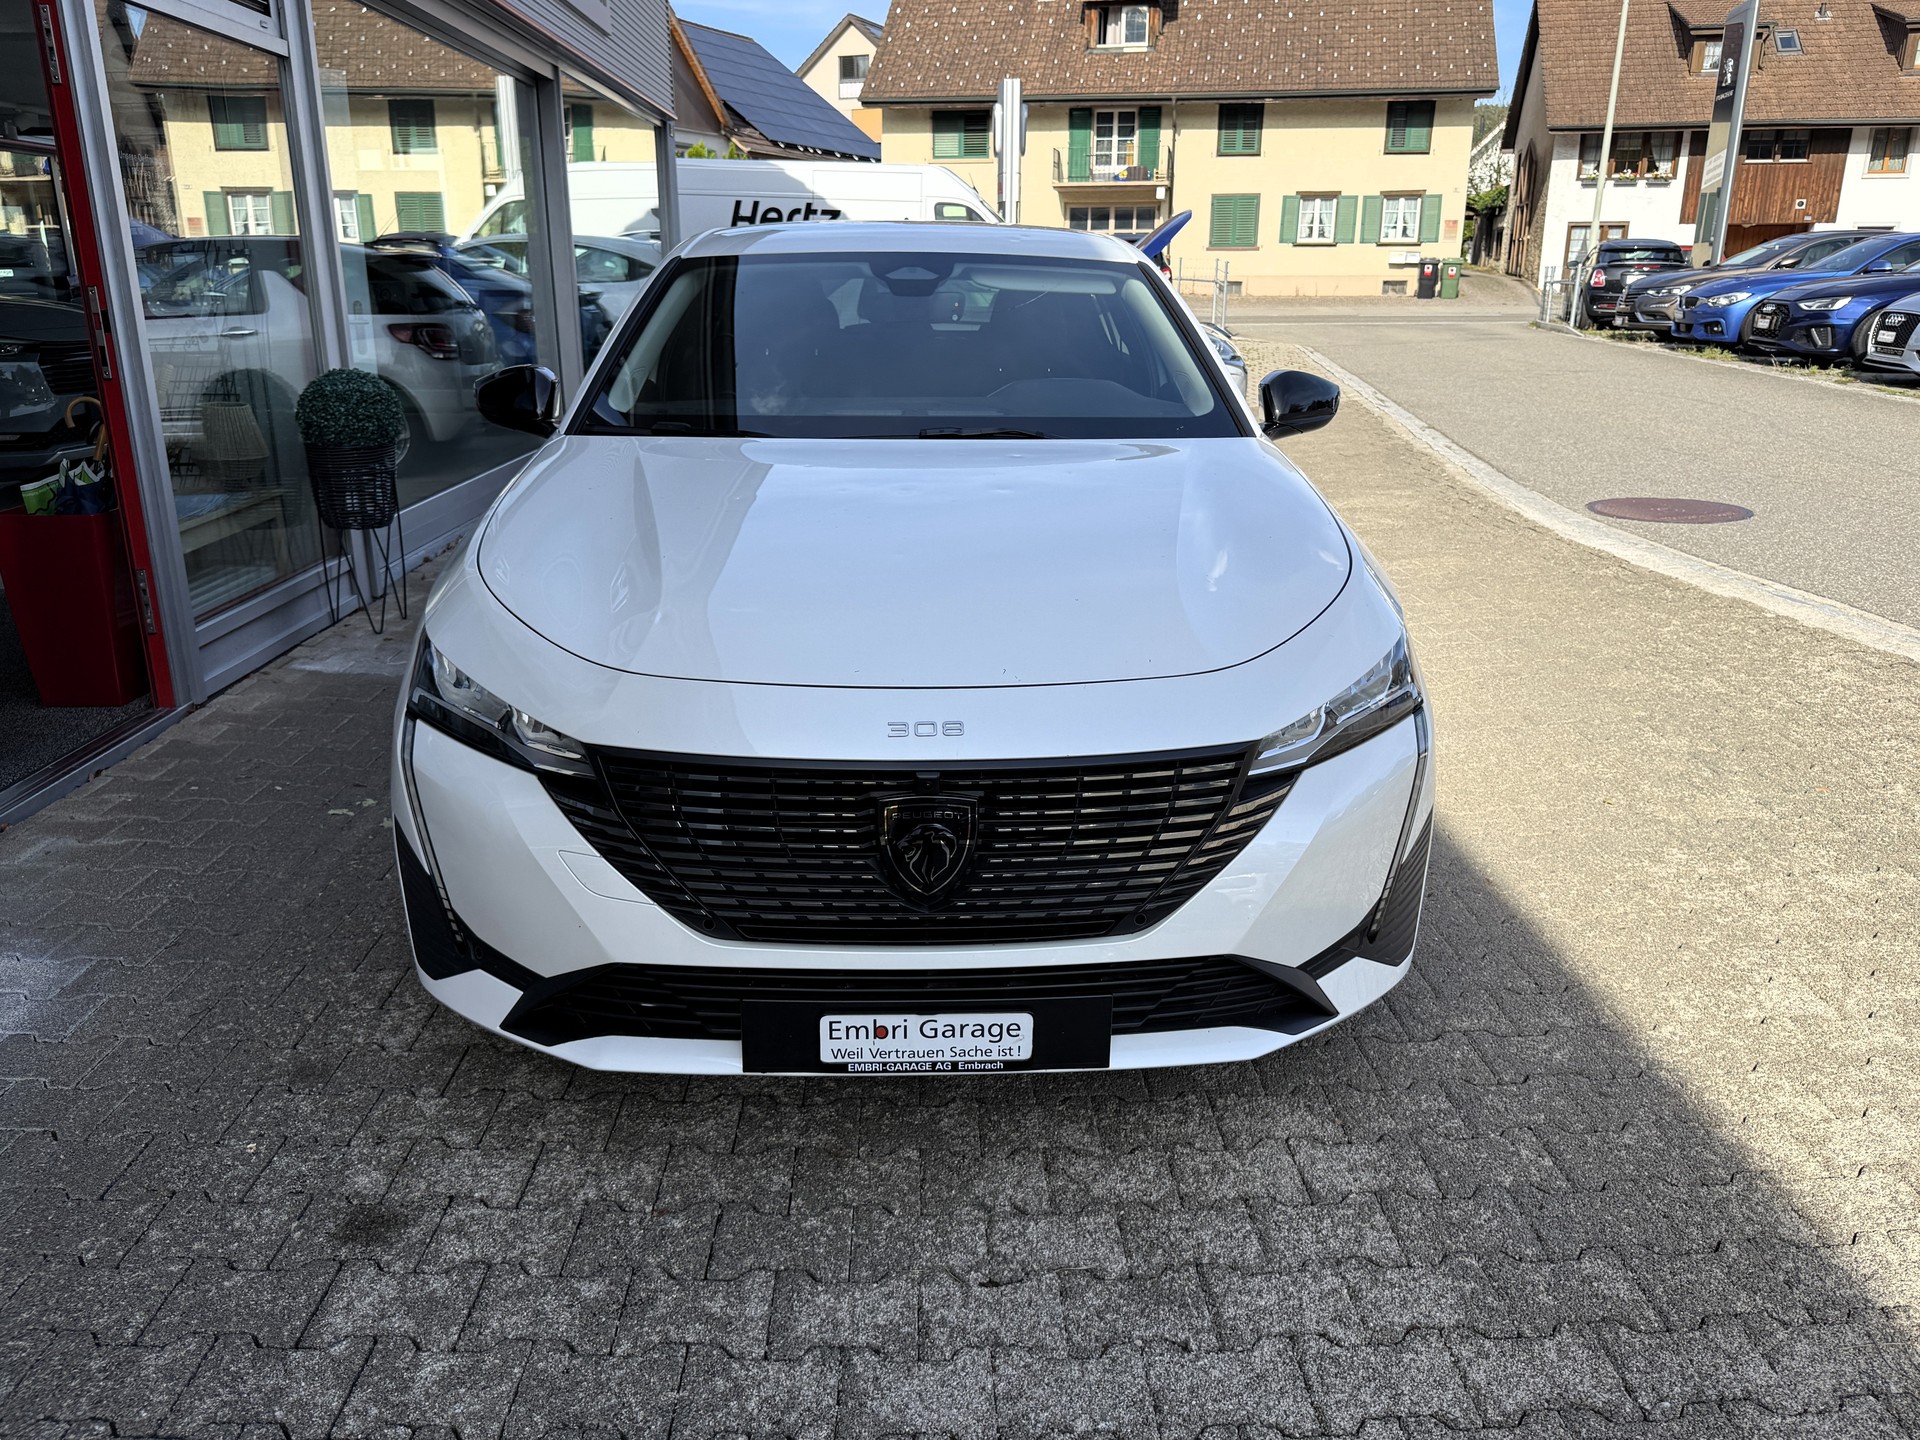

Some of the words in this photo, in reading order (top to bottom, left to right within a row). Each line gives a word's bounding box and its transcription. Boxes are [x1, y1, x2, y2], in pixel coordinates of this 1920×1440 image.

[887, 720, 965, 738] 308
[891, 811, 963, 820] PEUGEOT
[828, 1018, 908, 1040] Embri
[919, 1019, 1021, 1043] Garage
[830, 1046, 863, 1059] Weil
[868, 1046, 945, 1059] Vertrauen
[949, 1045, 993, 1058] Sache
[997, 1045, 1014, 1057] ist
[848, 1062, 932, 1072] EMBRI-GARAGE
[935, 1062, 952, 1070] AG
[958, 1060, 1004, 1070] Embrach
